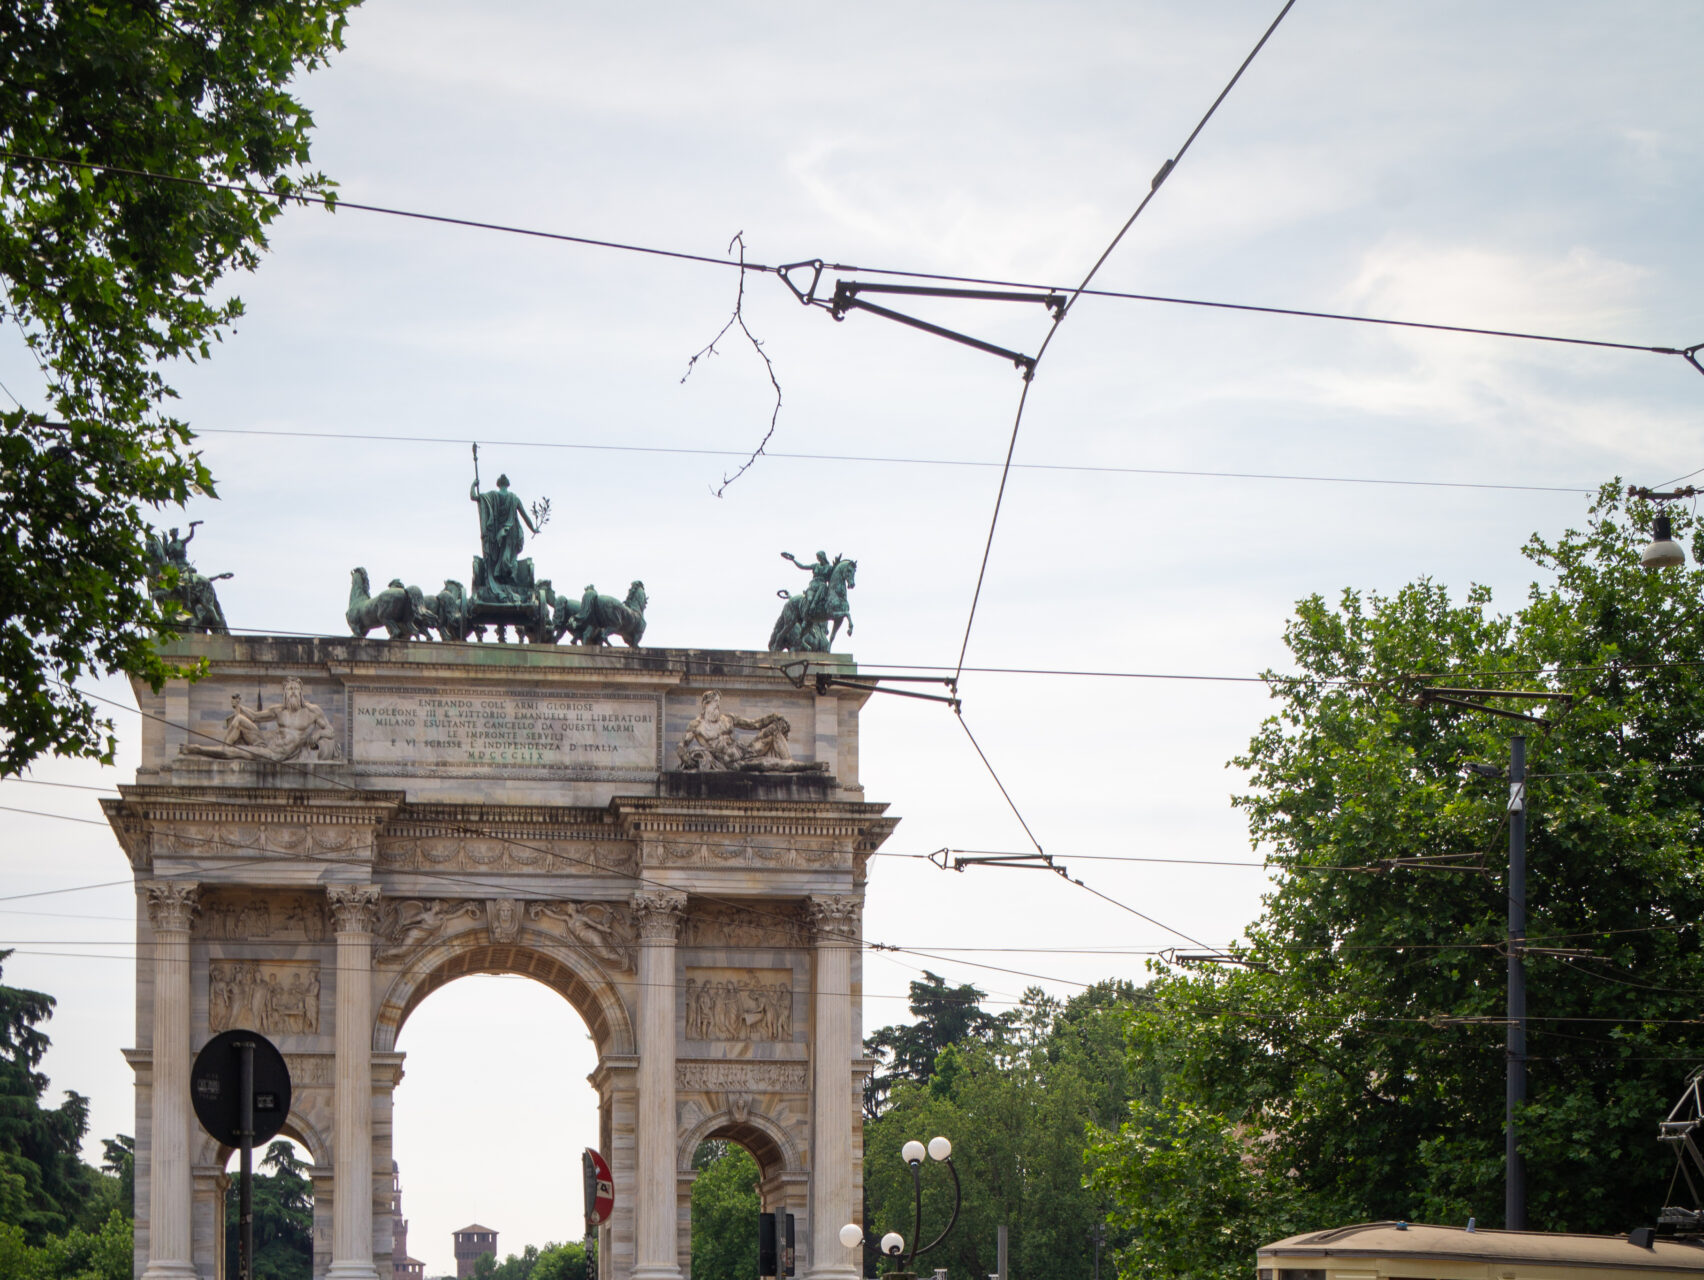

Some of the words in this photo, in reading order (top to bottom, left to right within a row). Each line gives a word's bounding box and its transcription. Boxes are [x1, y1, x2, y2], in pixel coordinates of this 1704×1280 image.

[418, 699, 473, 708] ENTRANDO
[514, 702, 538, 710] ARMI
[546, 702, 593, 711] GLORIOSE
[358, 707, 417, 717] NAPOLEONE
[426, 710, 436, 718] III
[444, 710, 451, 718] E
[458, 710, 507, 719] VITTORIO
[514, 712, 568, 721] EMANUELE
[576, 713, 583, 721] II
[591, 714, 652, 723] LIBERATORI
[375, 718, 416, 727] MILANO
[423, 720, 478, 729] ESULTANTE
[541, 723, 555, 731] DA
[561, 723, 597, 732] QUESTI
[602, 724, 635, 733] MARMI
[447, 730, 458, 739] LE
[466, 731, 518, 740] IMPRONTE
[526, 732, 564, 741] SERVILI
[391, 738, 397, 747] E
[405, 738, 416, 748] VI
[424, 739, 463, 749] SCRISSE
[483, 740, 561, 751] INDIPENDENZA
[584, 743, 619, 752] ITALIA
